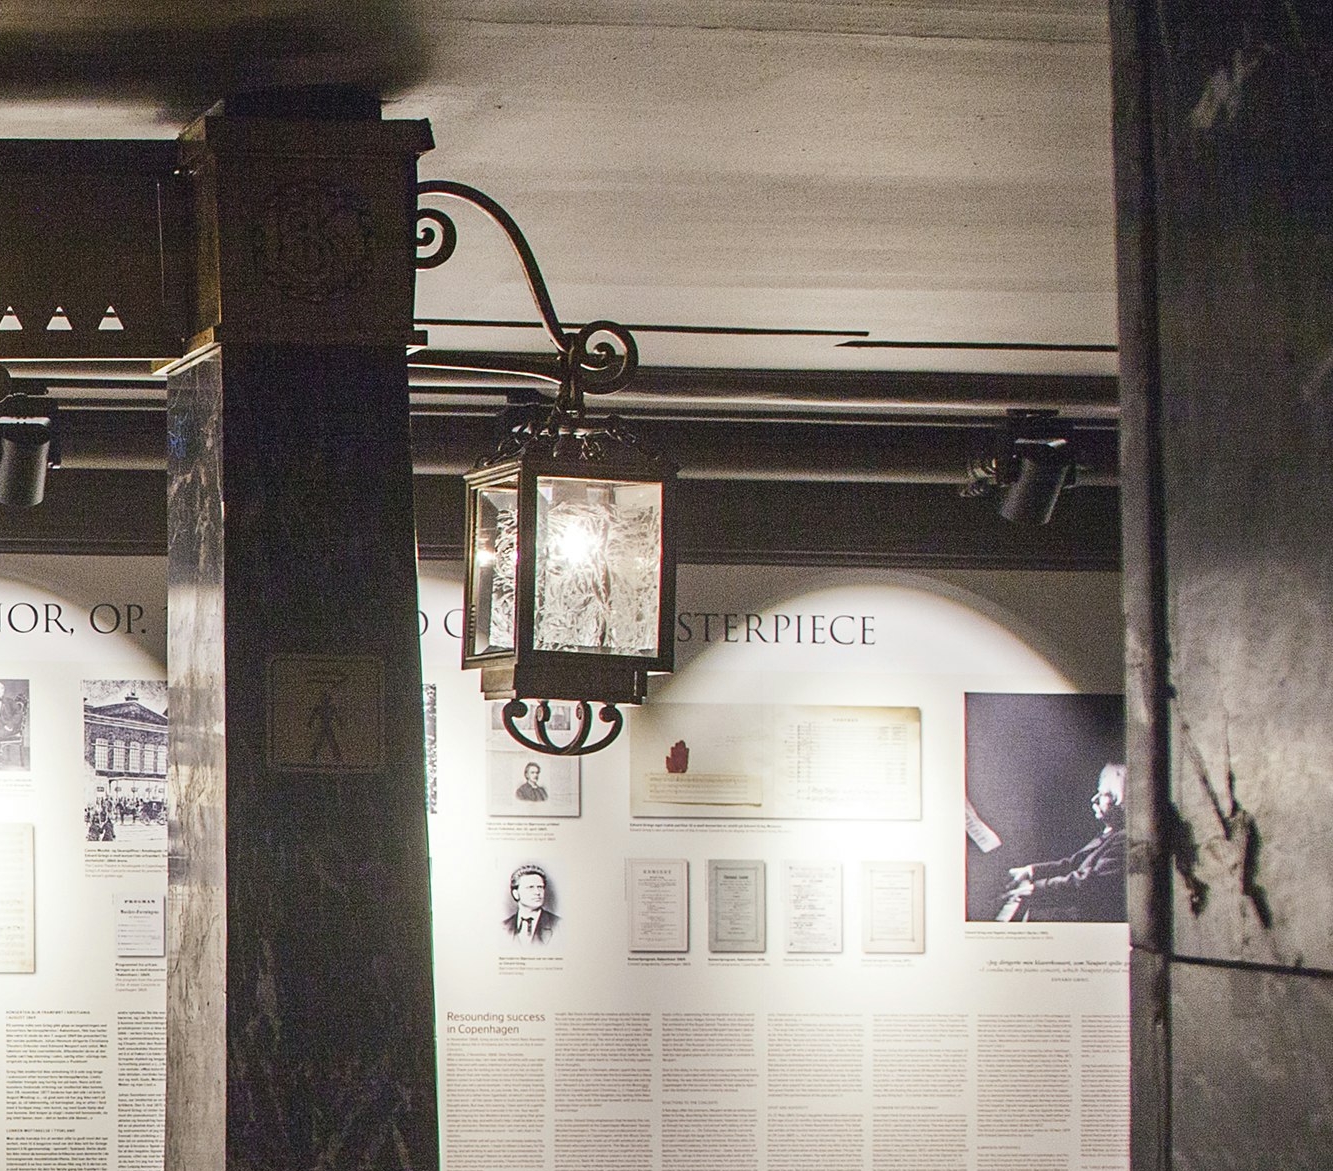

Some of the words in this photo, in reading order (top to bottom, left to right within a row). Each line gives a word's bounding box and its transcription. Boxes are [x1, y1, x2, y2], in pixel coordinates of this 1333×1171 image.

[89, 603, 147, 635] OP.
[676, 611, 877, 646] STERPIECE
[446, 1011, 504, 1023] Resounding
[507, 1013, 546, 1022] success
[446, 1024, 456, 1034] in
[458, 1024, 520, 1036] Copenhagen
